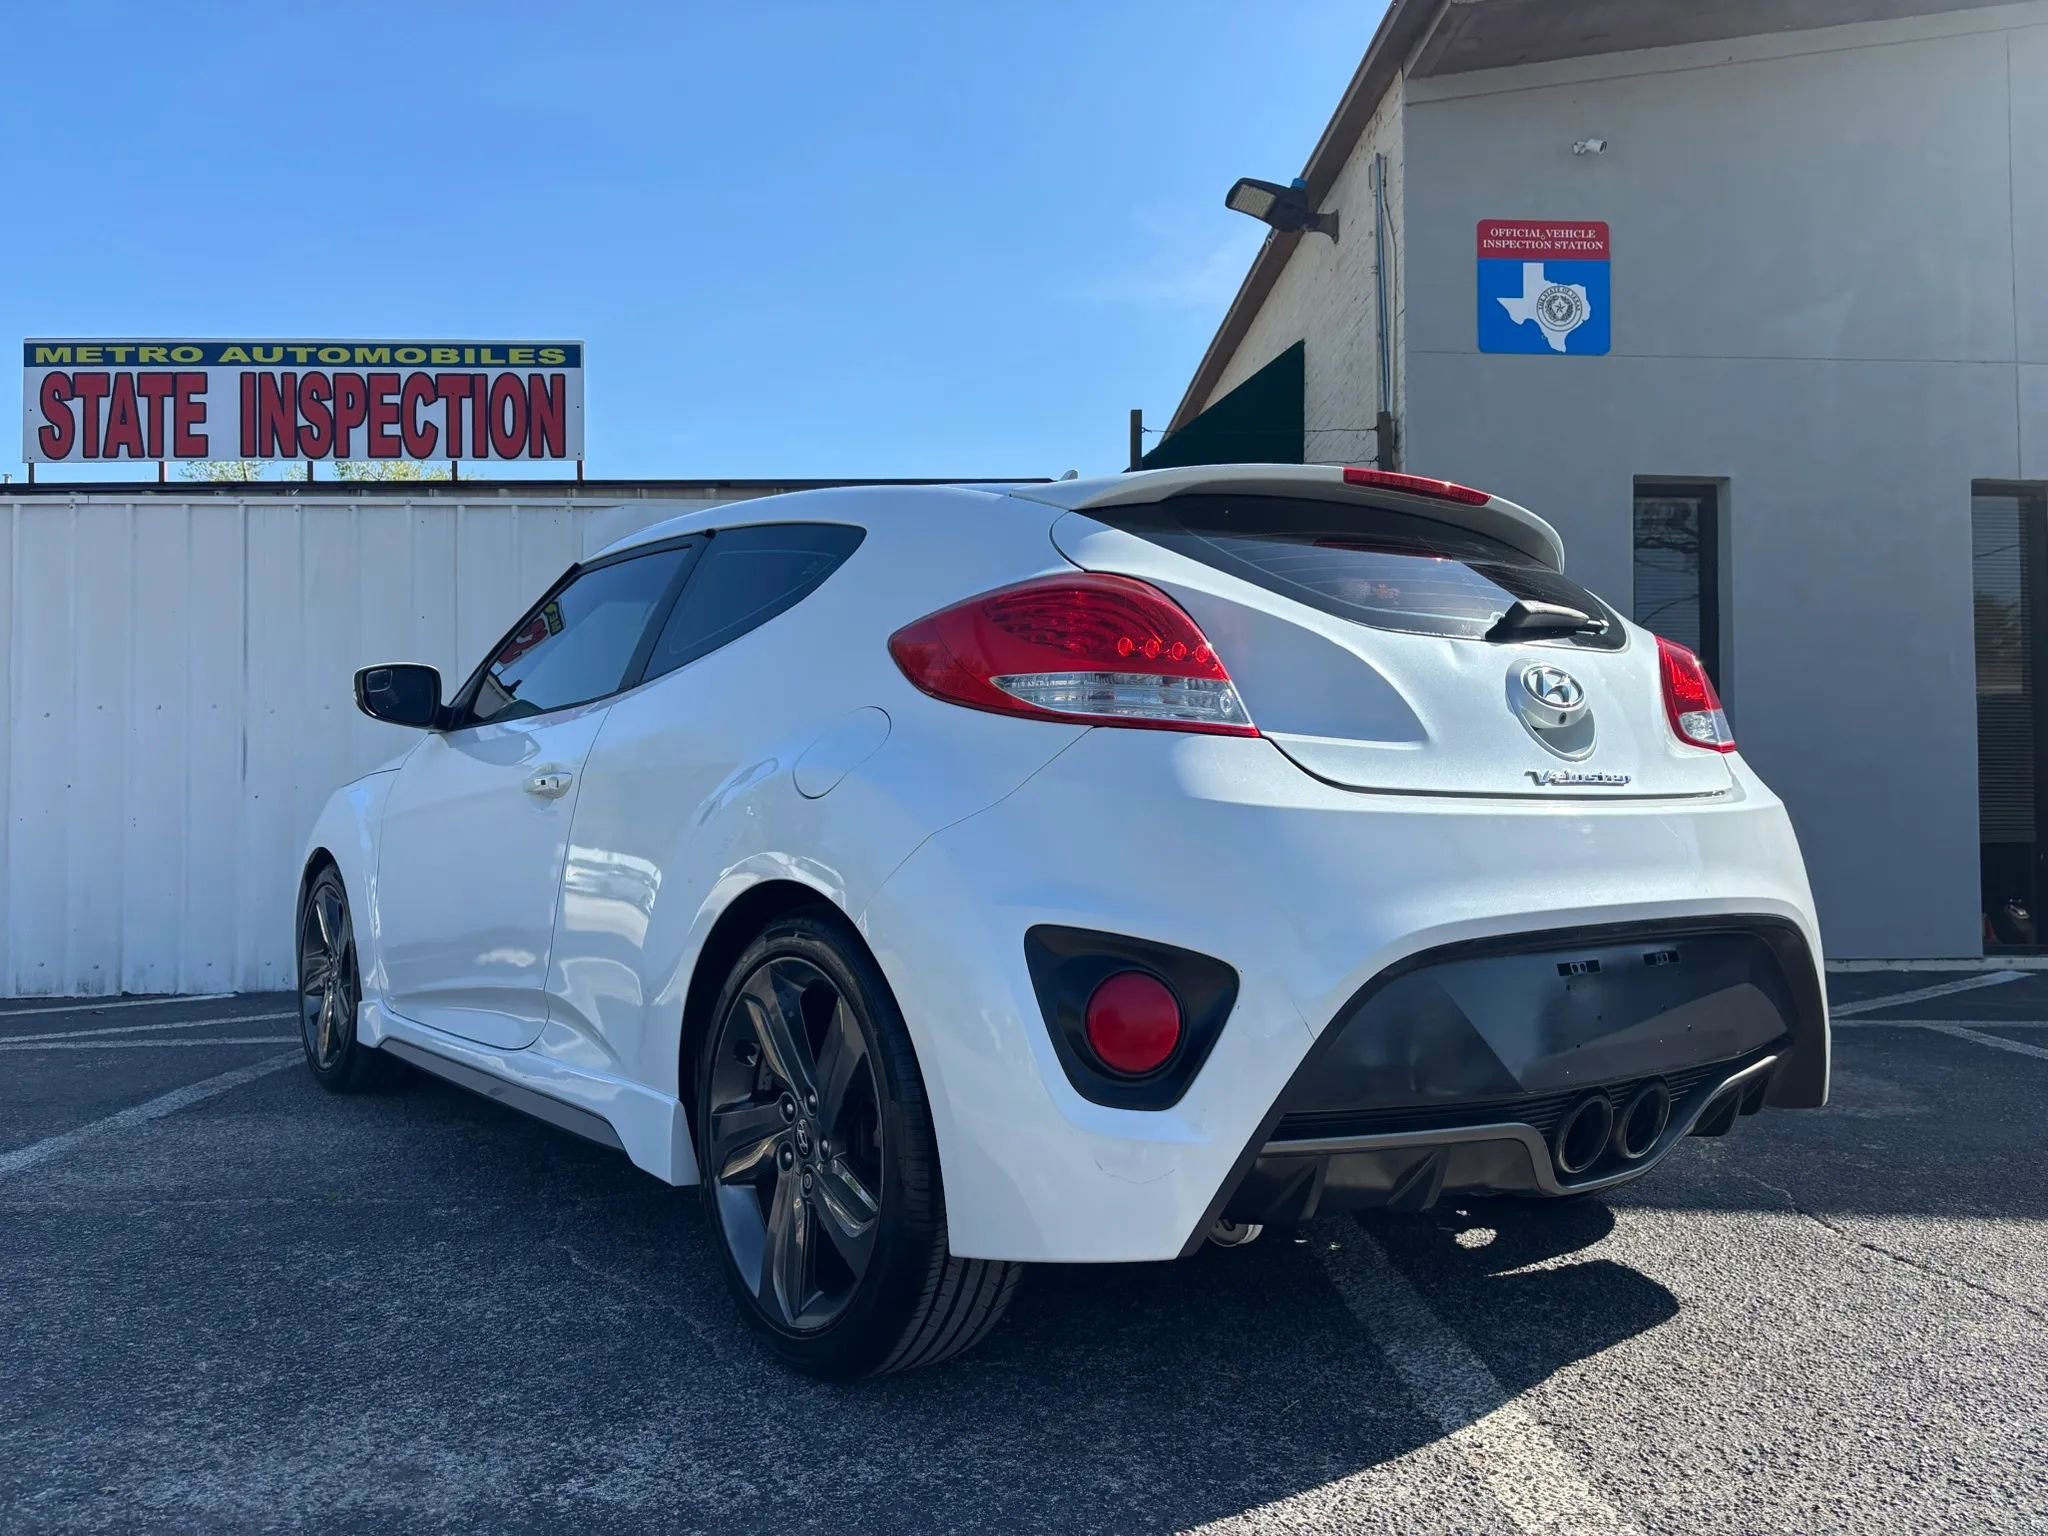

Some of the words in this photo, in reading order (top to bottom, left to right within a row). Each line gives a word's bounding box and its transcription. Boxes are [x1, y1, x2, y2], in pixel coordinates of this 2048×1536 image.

[1490, 228, 1542, 238] OFFICIAL
[1546, 229, 1596, 239] VEHICLE
[1483, 239, 1552, 249] INSPECTION
[1554, 240, 1604, 250] STATION
[35, 345, 204, 364] METRO
[218, 346, 567, 365] AUTOMOBILES
[38, 371, 209, 460] STATE
[240, 371, 566, 460] INSPECTION
